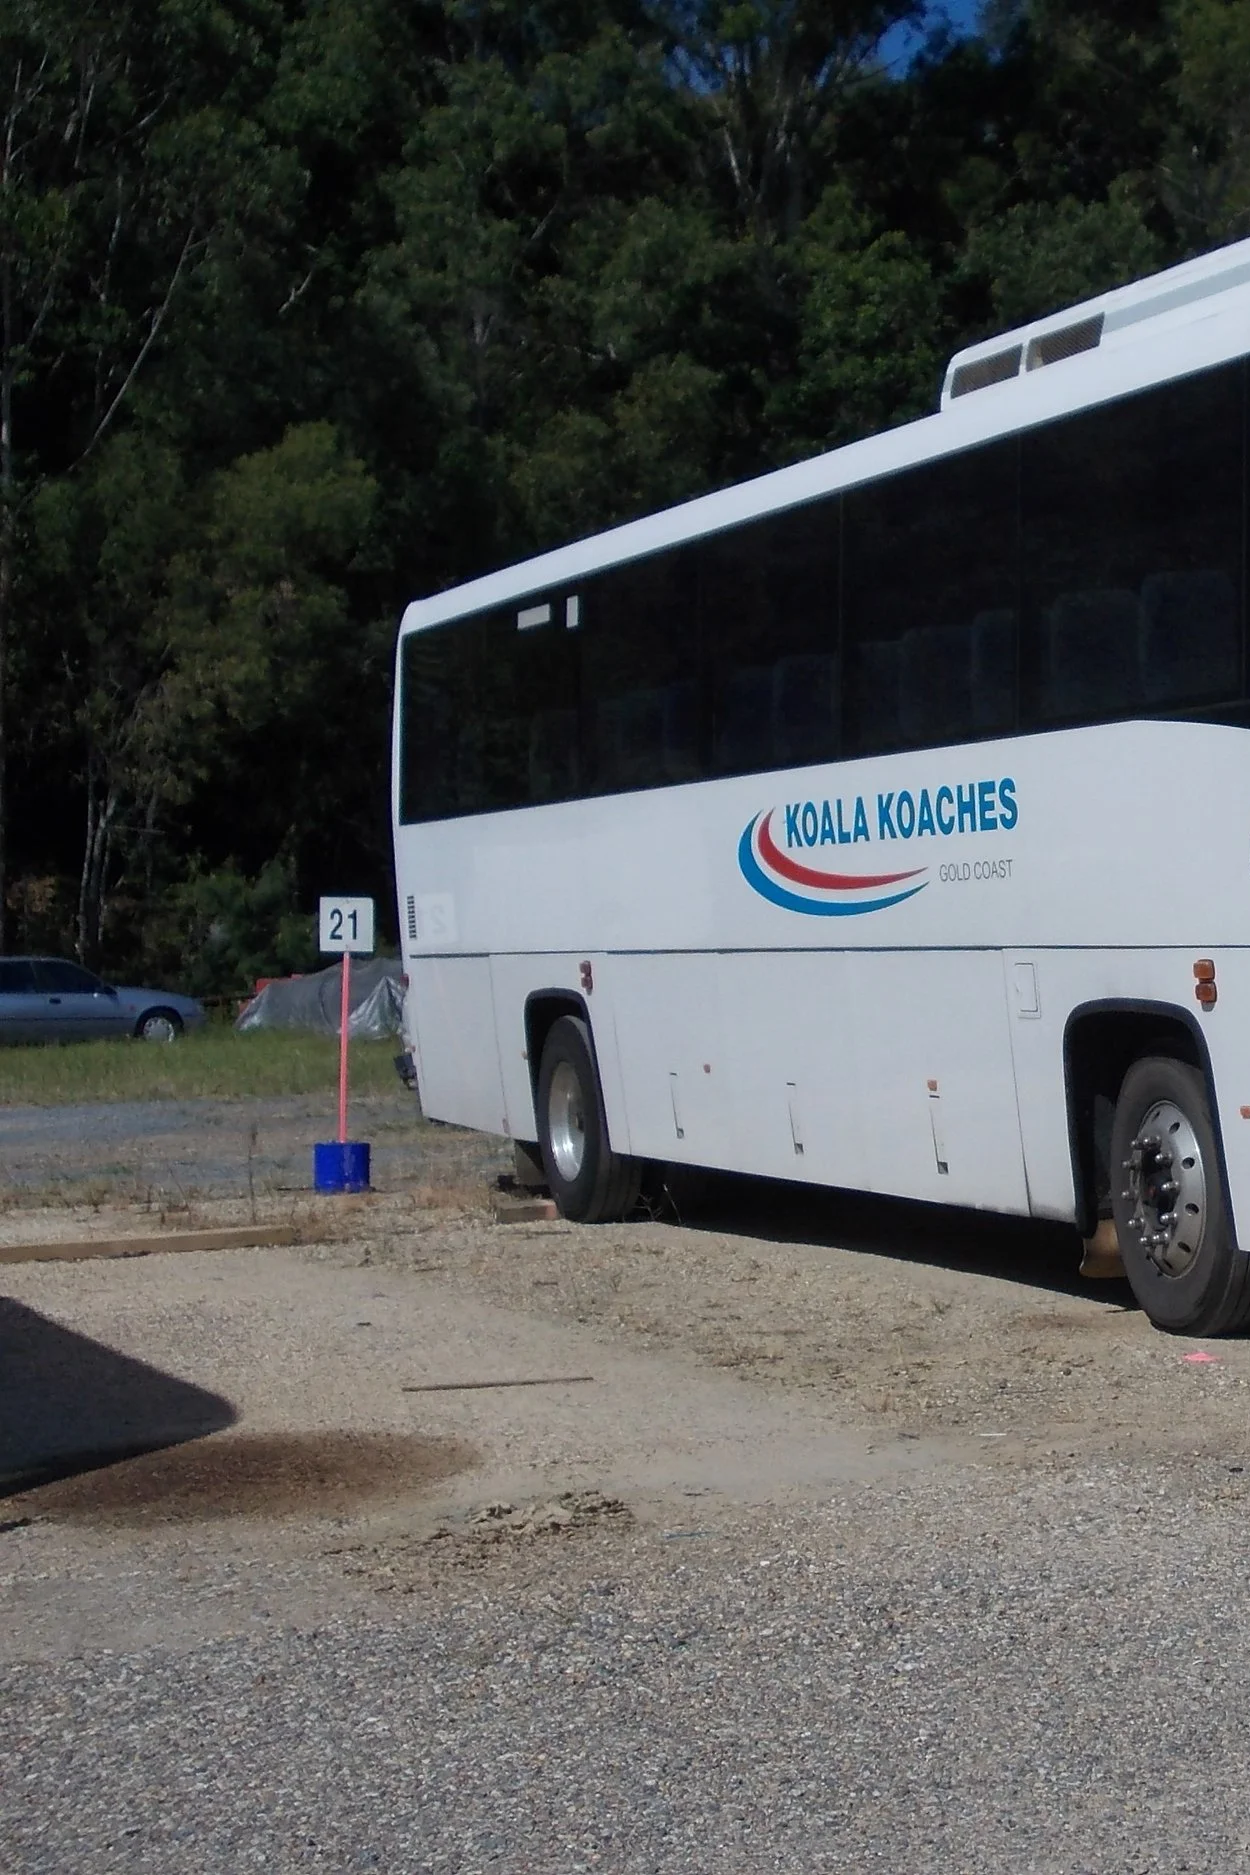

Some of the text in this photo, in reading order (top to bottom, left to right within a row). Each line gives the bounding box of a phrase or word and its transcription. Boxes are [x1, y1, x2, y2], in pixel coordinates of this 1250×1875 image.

[785, 777, 1018, 848] KOALA KOACHES
[939, 859, 1013, 882] GOLD COAST
[329, 908, 357, 940] 21
